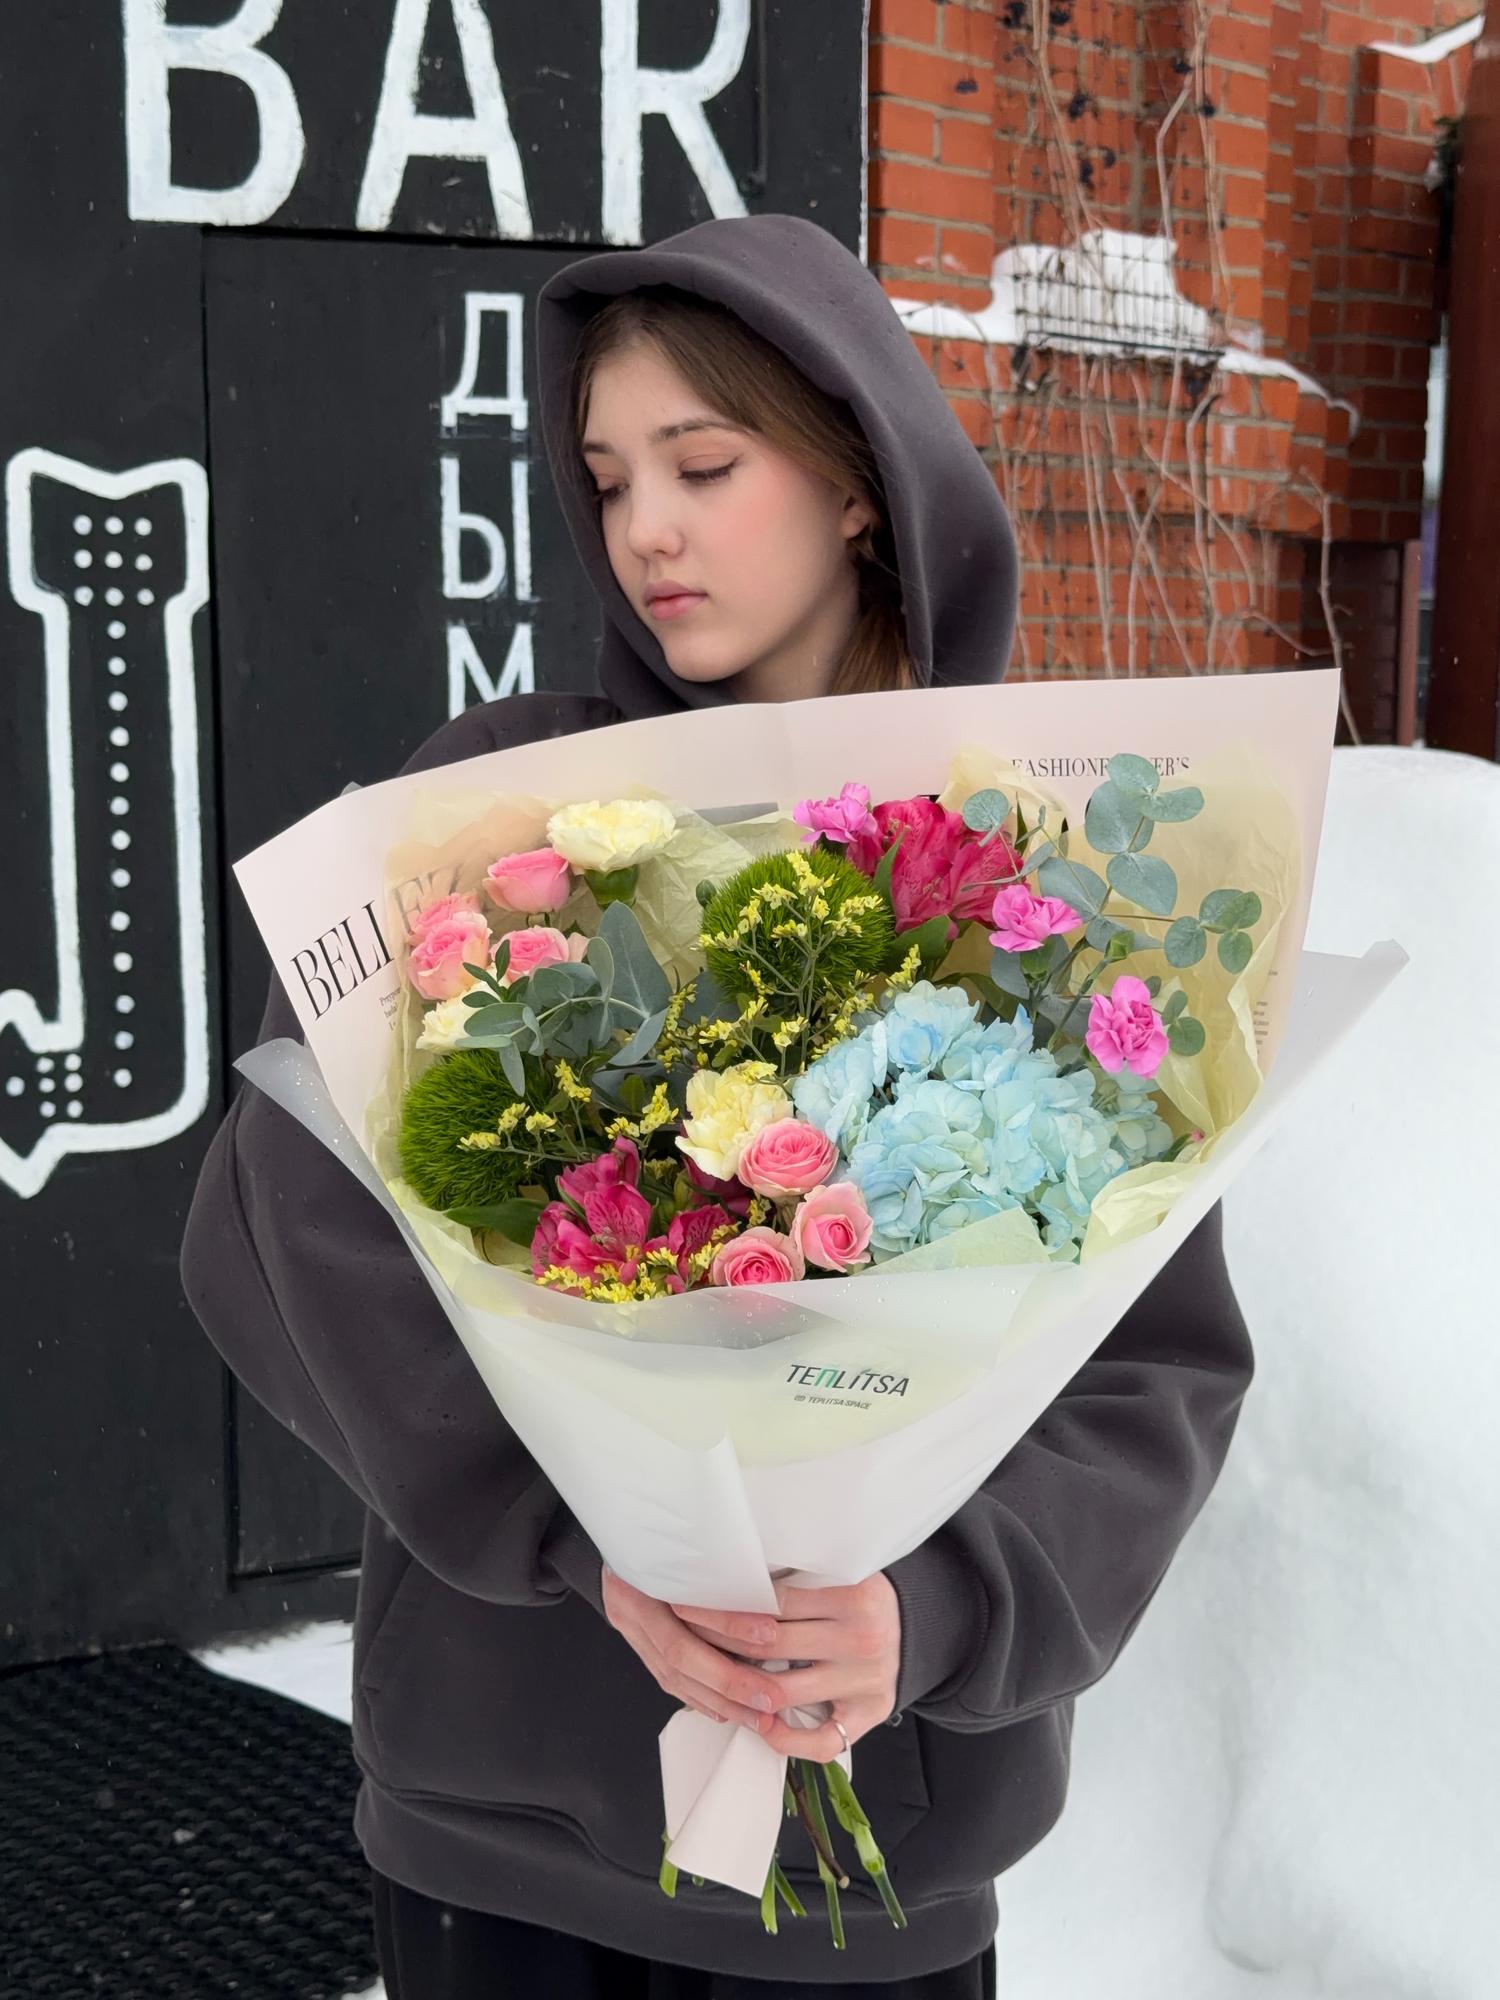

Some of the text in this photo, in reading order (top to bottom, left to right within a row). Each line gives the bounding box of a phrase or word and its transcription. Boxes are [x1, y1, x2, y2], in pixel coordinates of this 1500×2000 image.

[122, 0, 750, 247] BAR
[437, 291, 536, 722] ДЫМ
[1012, 755, 1191, 778] ASHIONFER'S
